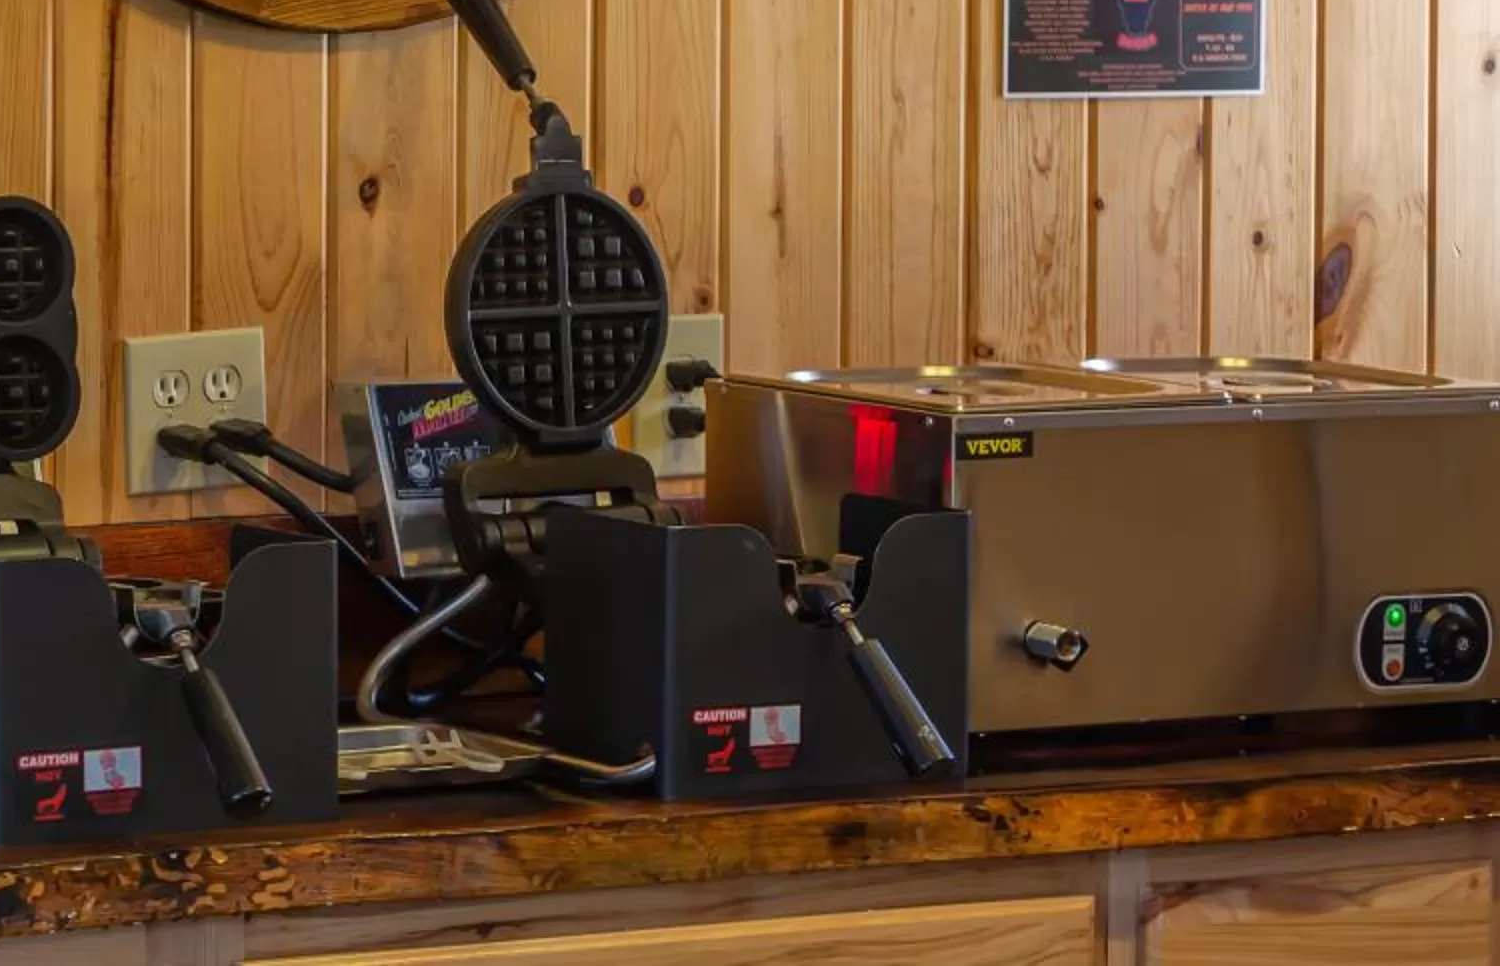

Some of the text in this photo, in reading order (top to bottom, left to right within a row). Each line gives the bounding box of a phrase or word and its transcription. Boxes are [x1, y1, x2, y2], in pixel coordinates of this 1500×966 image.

[965, 437, 1024, 455] VEVOR
[693, 707, 749, 723] CAUTION
[19, 751, 80, 769] CAUTION
